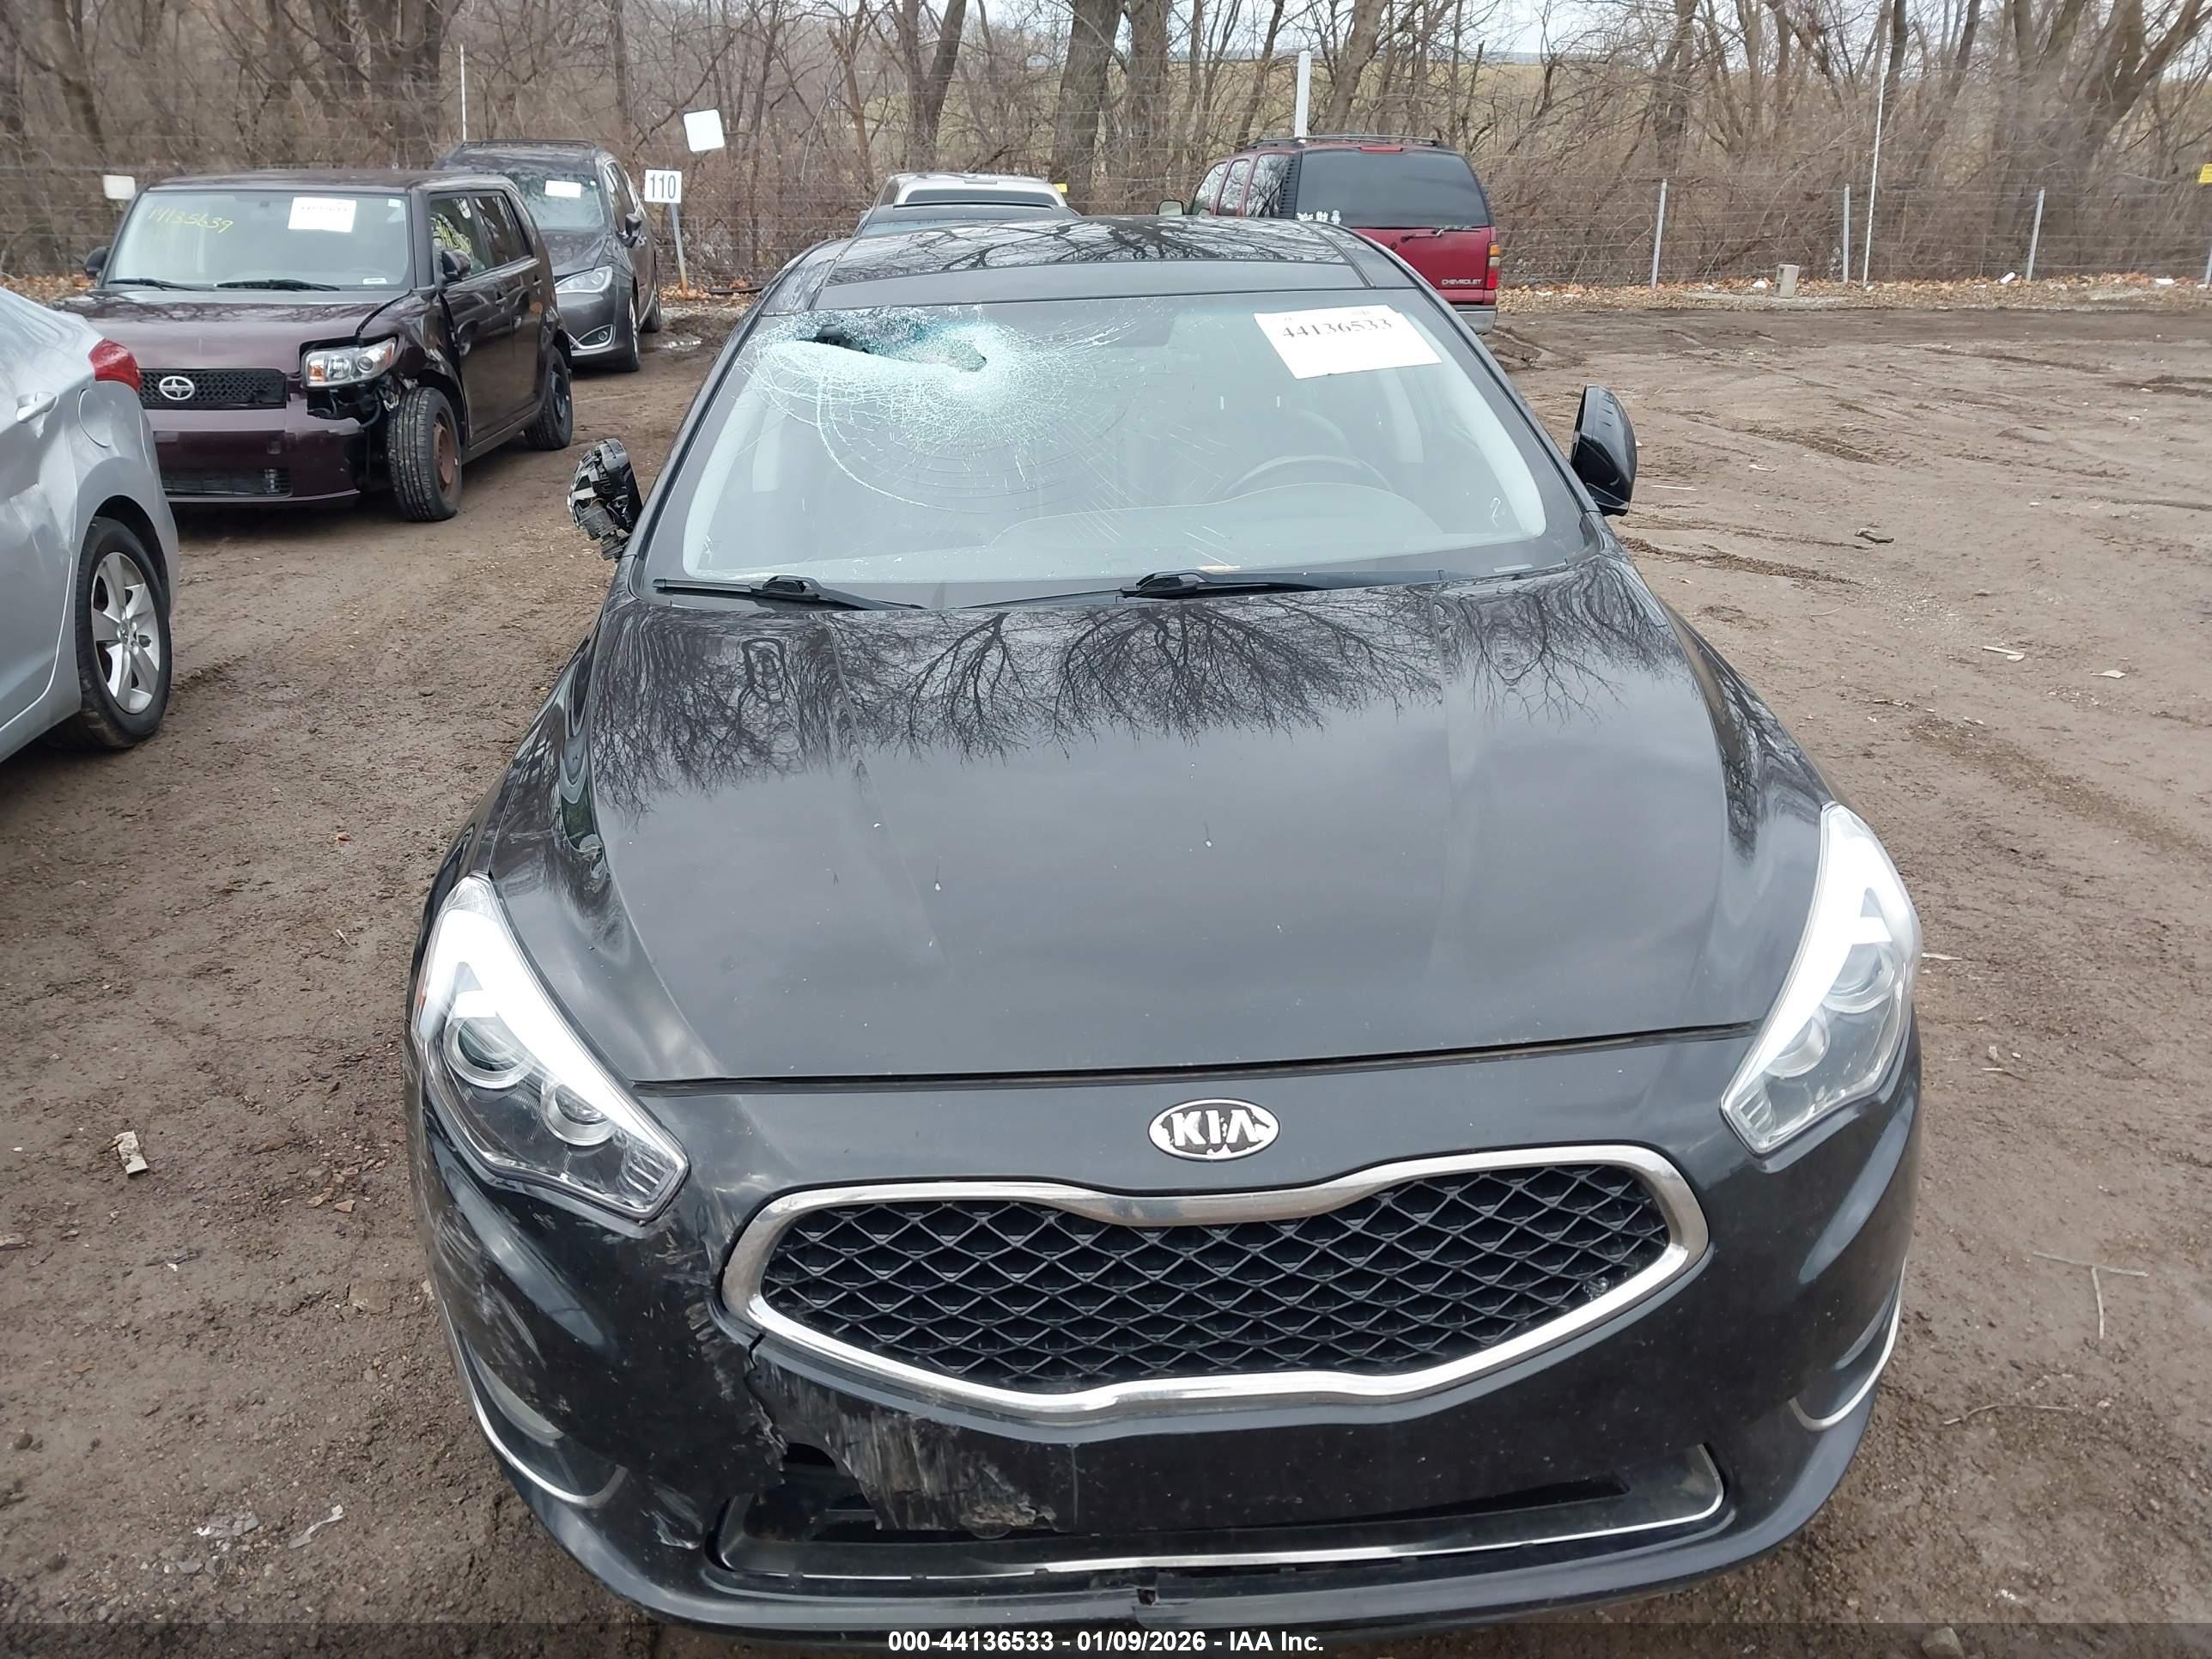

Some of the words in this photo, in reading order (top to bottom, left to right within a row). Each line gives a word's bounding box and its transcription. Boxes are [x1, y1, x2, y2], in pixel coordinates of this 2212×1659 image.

[649, 173, 677, 199] 110
[1282, 318, 1393, 338] 44136533
[1170, 1109, 1261, 1147] KIA
